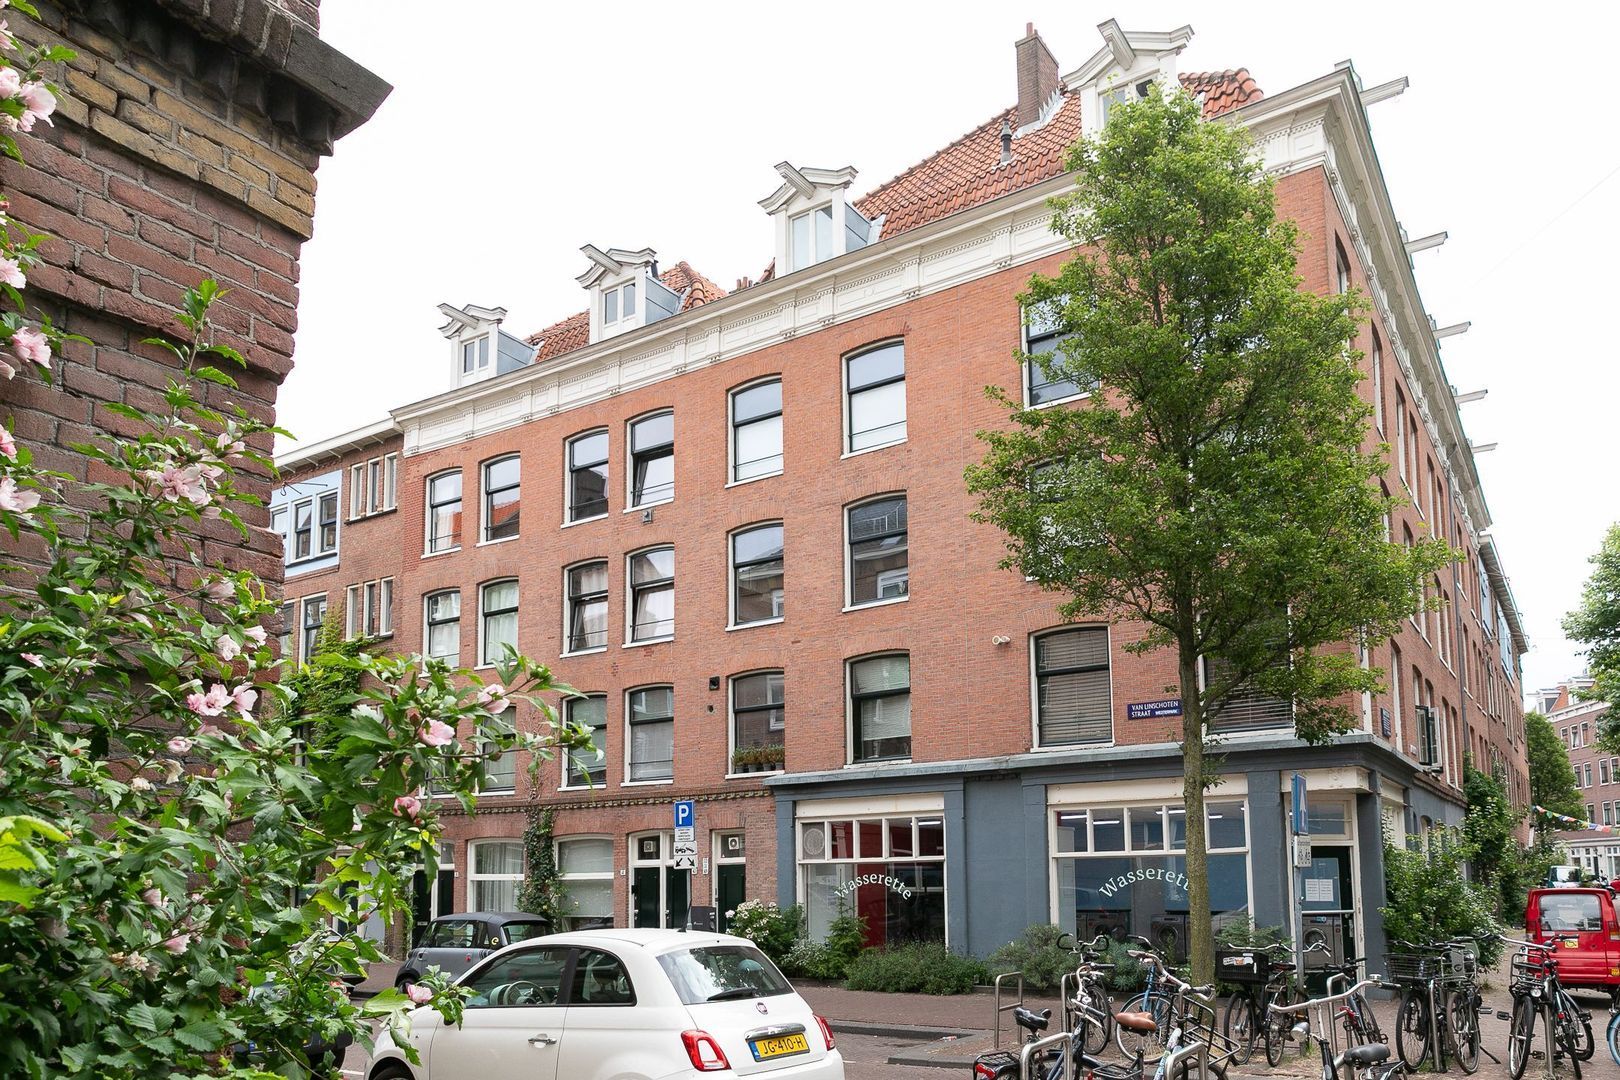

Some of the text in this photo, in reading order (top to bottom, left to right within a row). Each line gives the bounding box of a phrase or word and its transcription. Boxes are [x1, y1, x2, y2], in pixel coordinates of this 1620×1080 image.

[1131, 703, 1143, 711] VAN
[1131, 710, 1151, 718] STRAAT
[678, 804, 690, 825] P
[834, 873, 912, 900] Wasserette
[763, 1036, 805, 1055] JG-410-H
